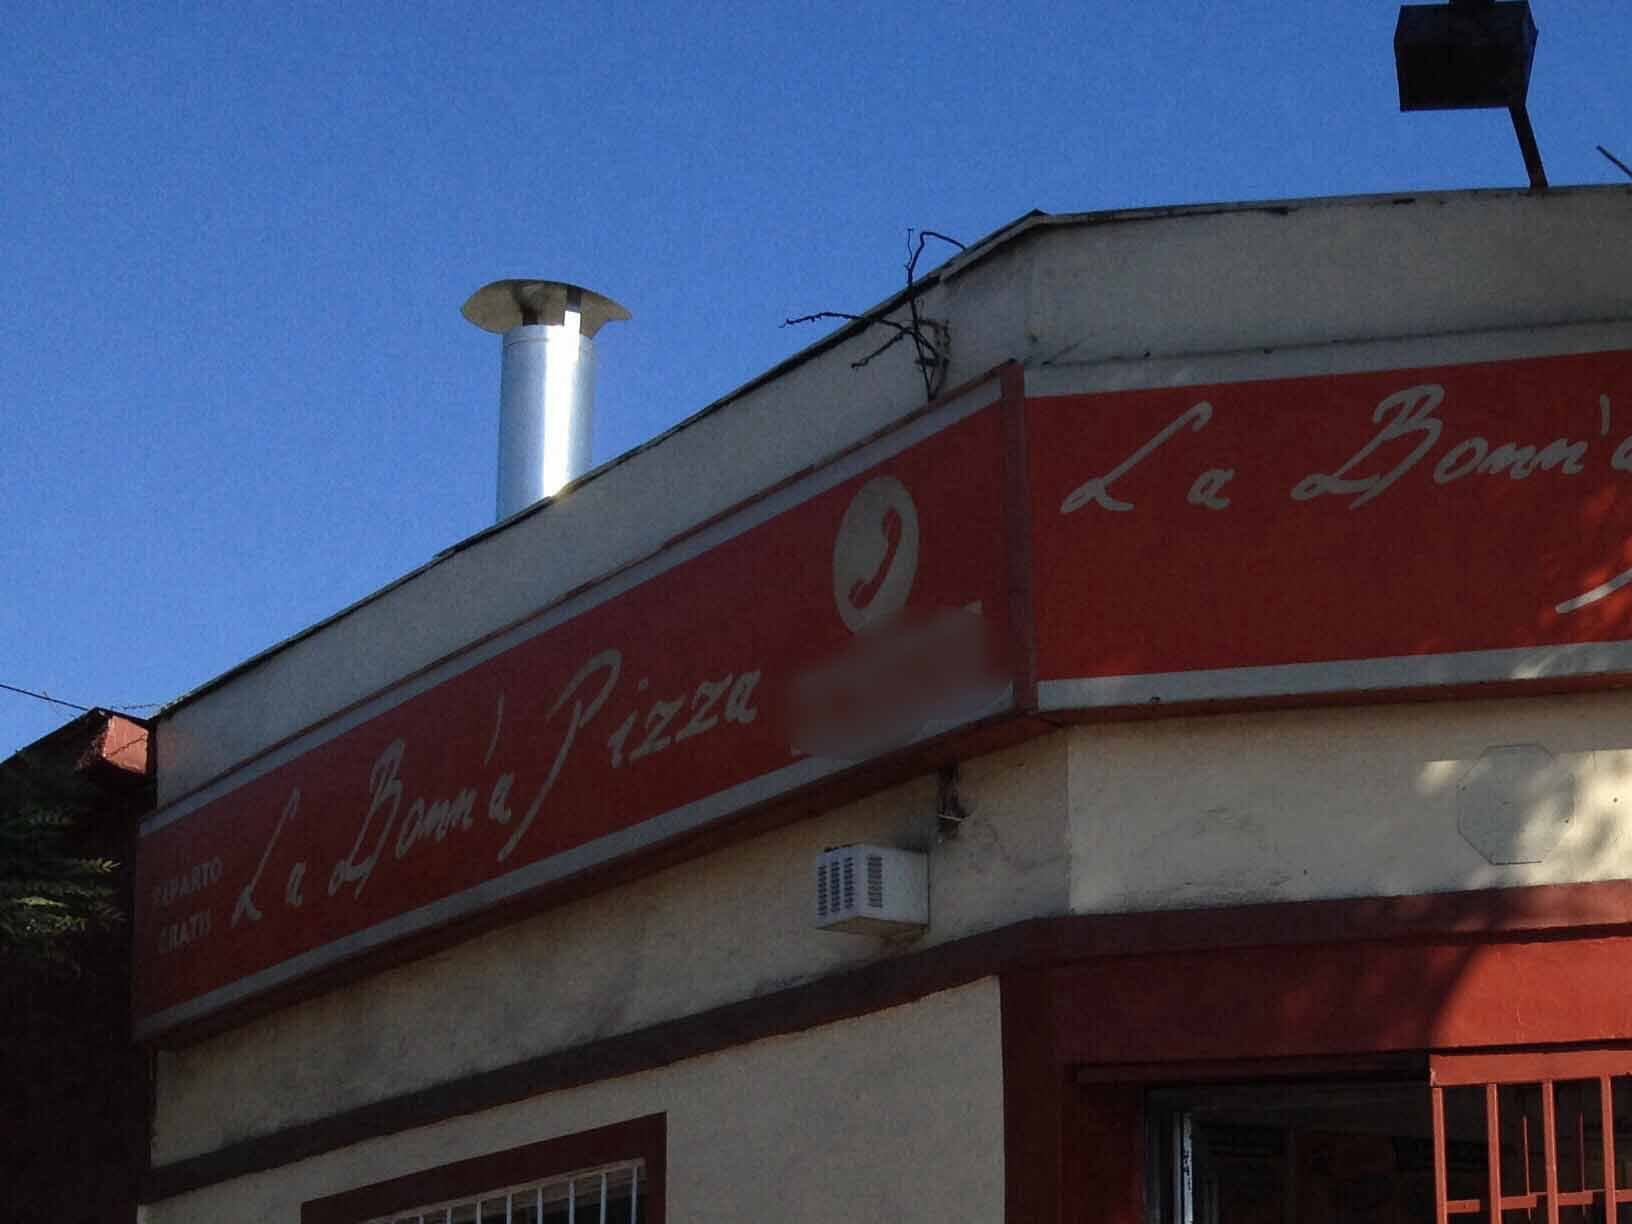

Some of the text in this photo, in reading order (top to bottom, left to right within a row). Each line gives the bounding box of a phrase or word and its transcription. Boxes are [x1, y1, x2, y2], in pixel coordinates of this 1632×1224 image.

[1061, 401, 1231, 515] La
[231, 788, 304, 926] La
[497, 648, 762, 862] Pizza
